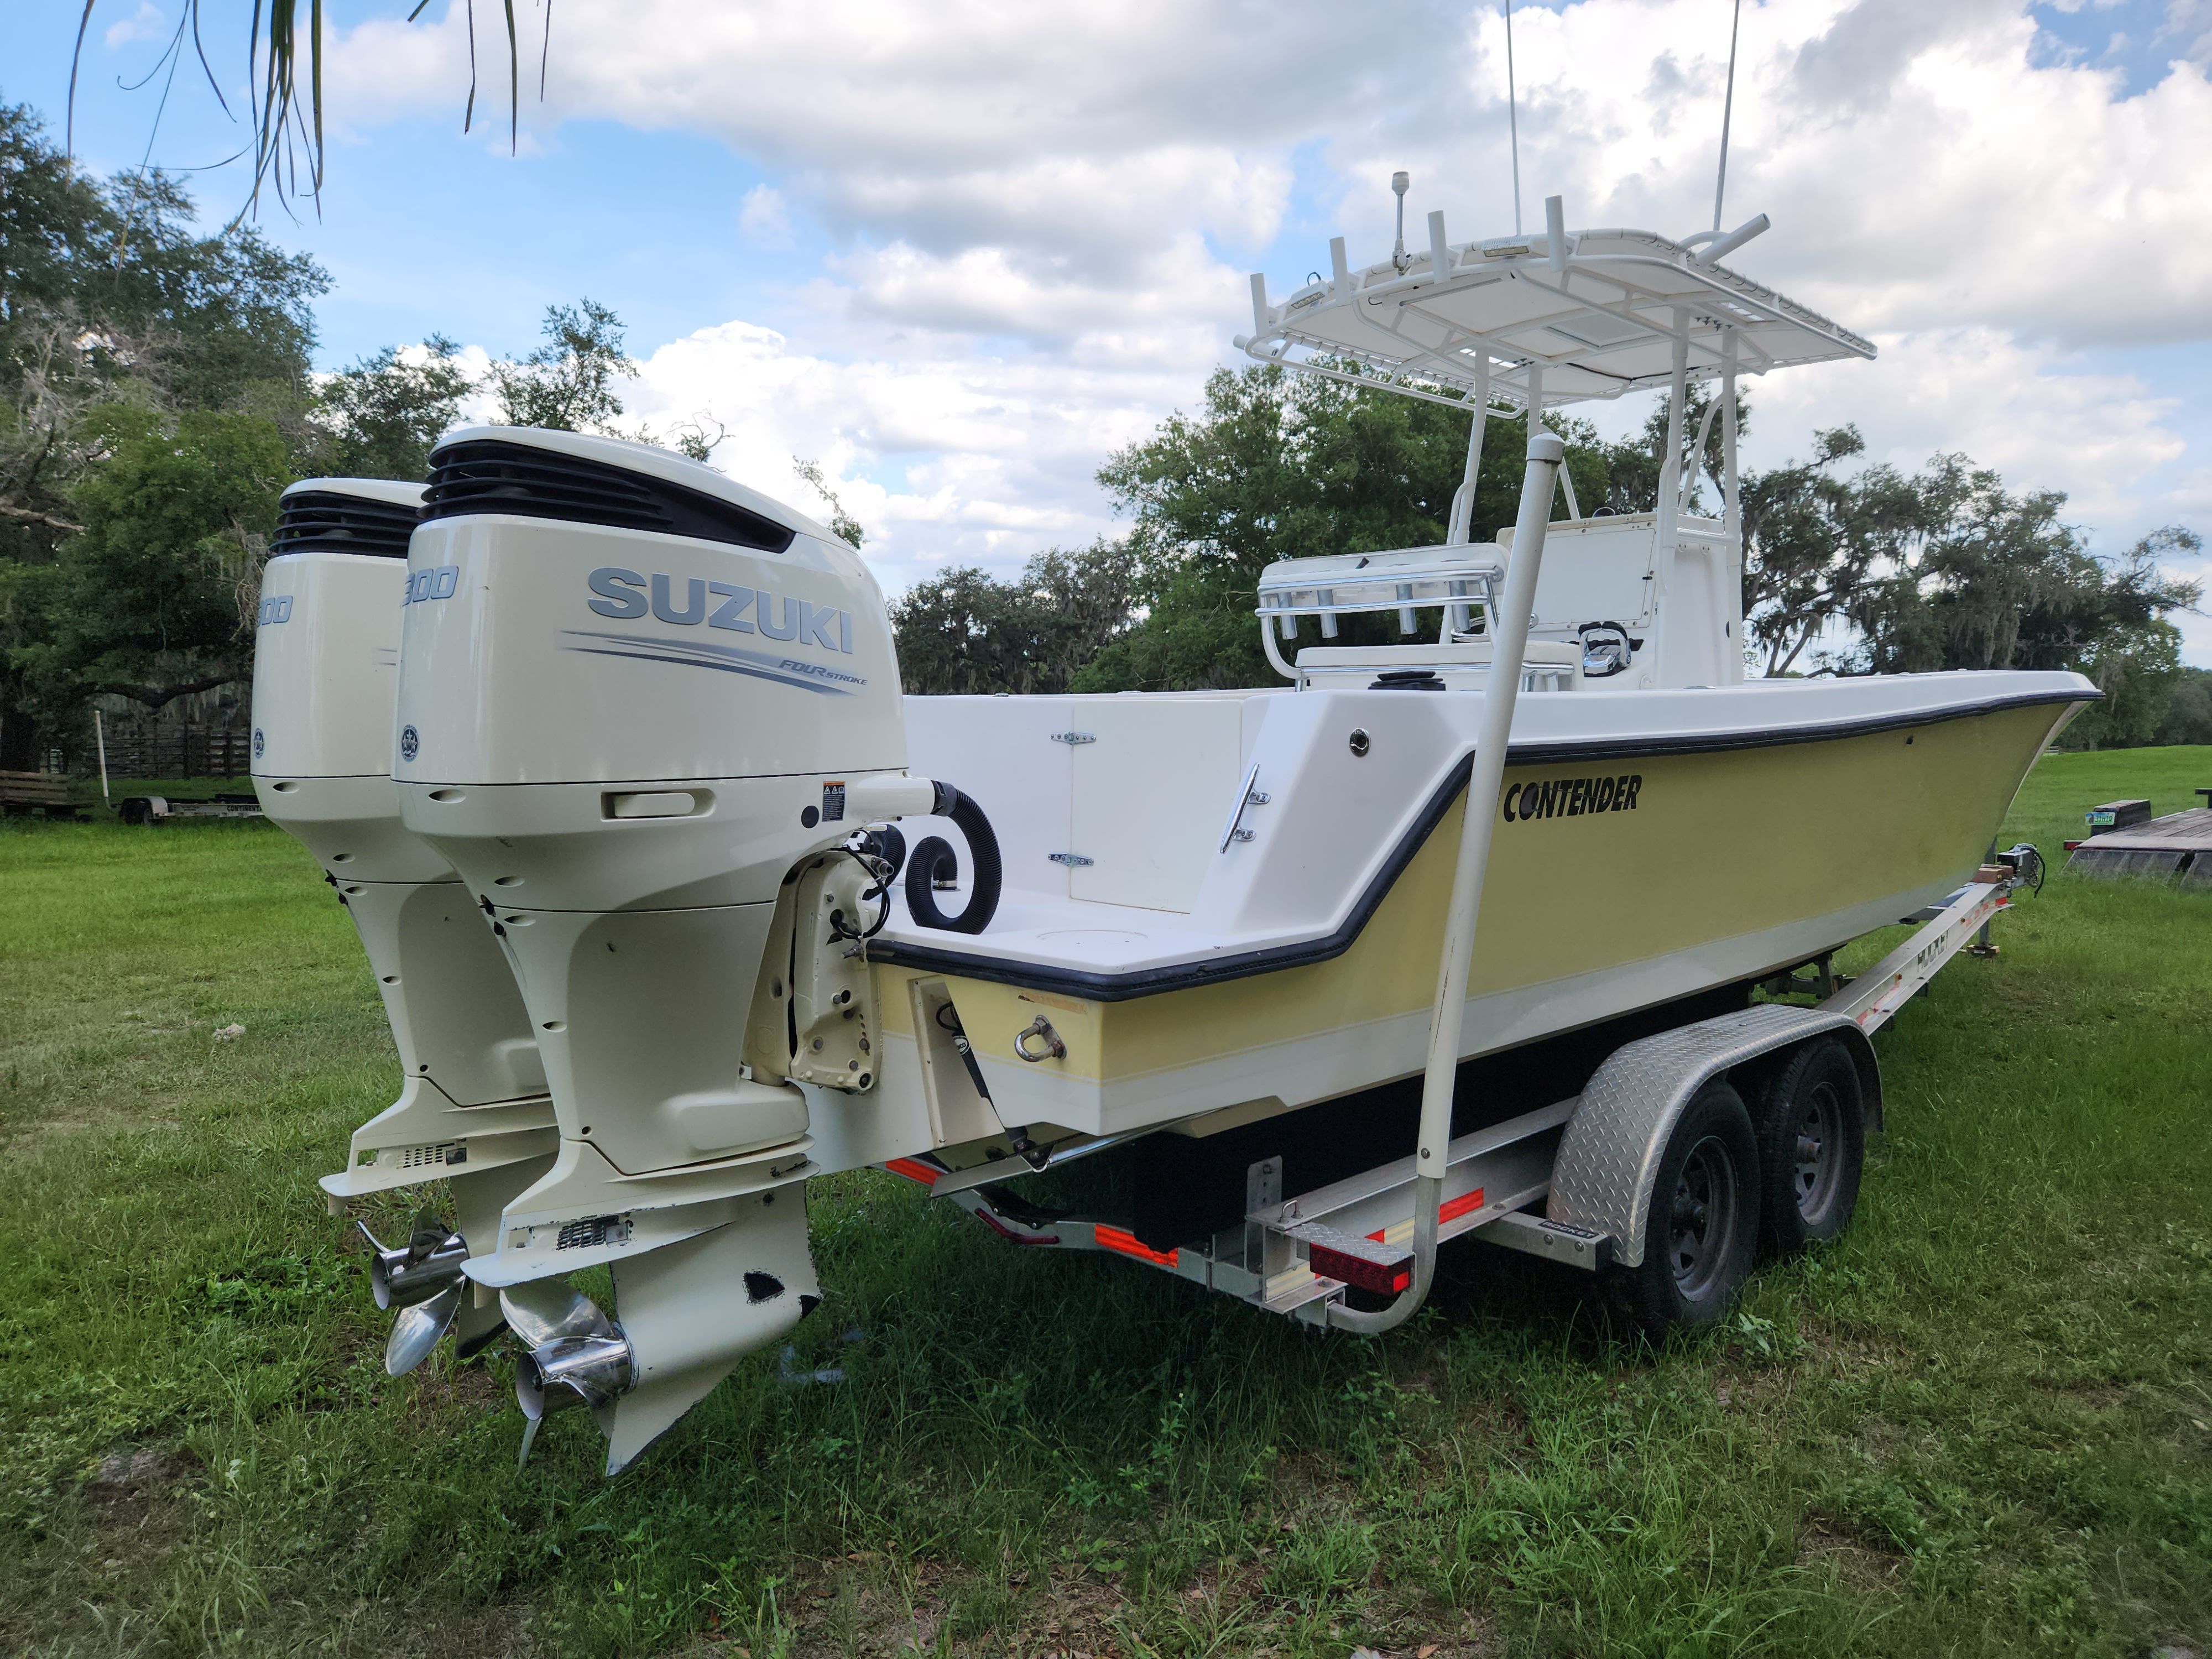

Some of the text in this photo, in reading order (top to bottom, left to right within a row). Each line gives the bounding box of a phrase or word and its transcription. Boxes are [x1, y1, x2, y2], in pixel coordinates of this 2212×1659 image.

[587, 566, 853, 654] SUZUKI
[1503, 774, 1642, 822] CONTENDER
[1542, 1221, 1595, 1238] ROCKET
